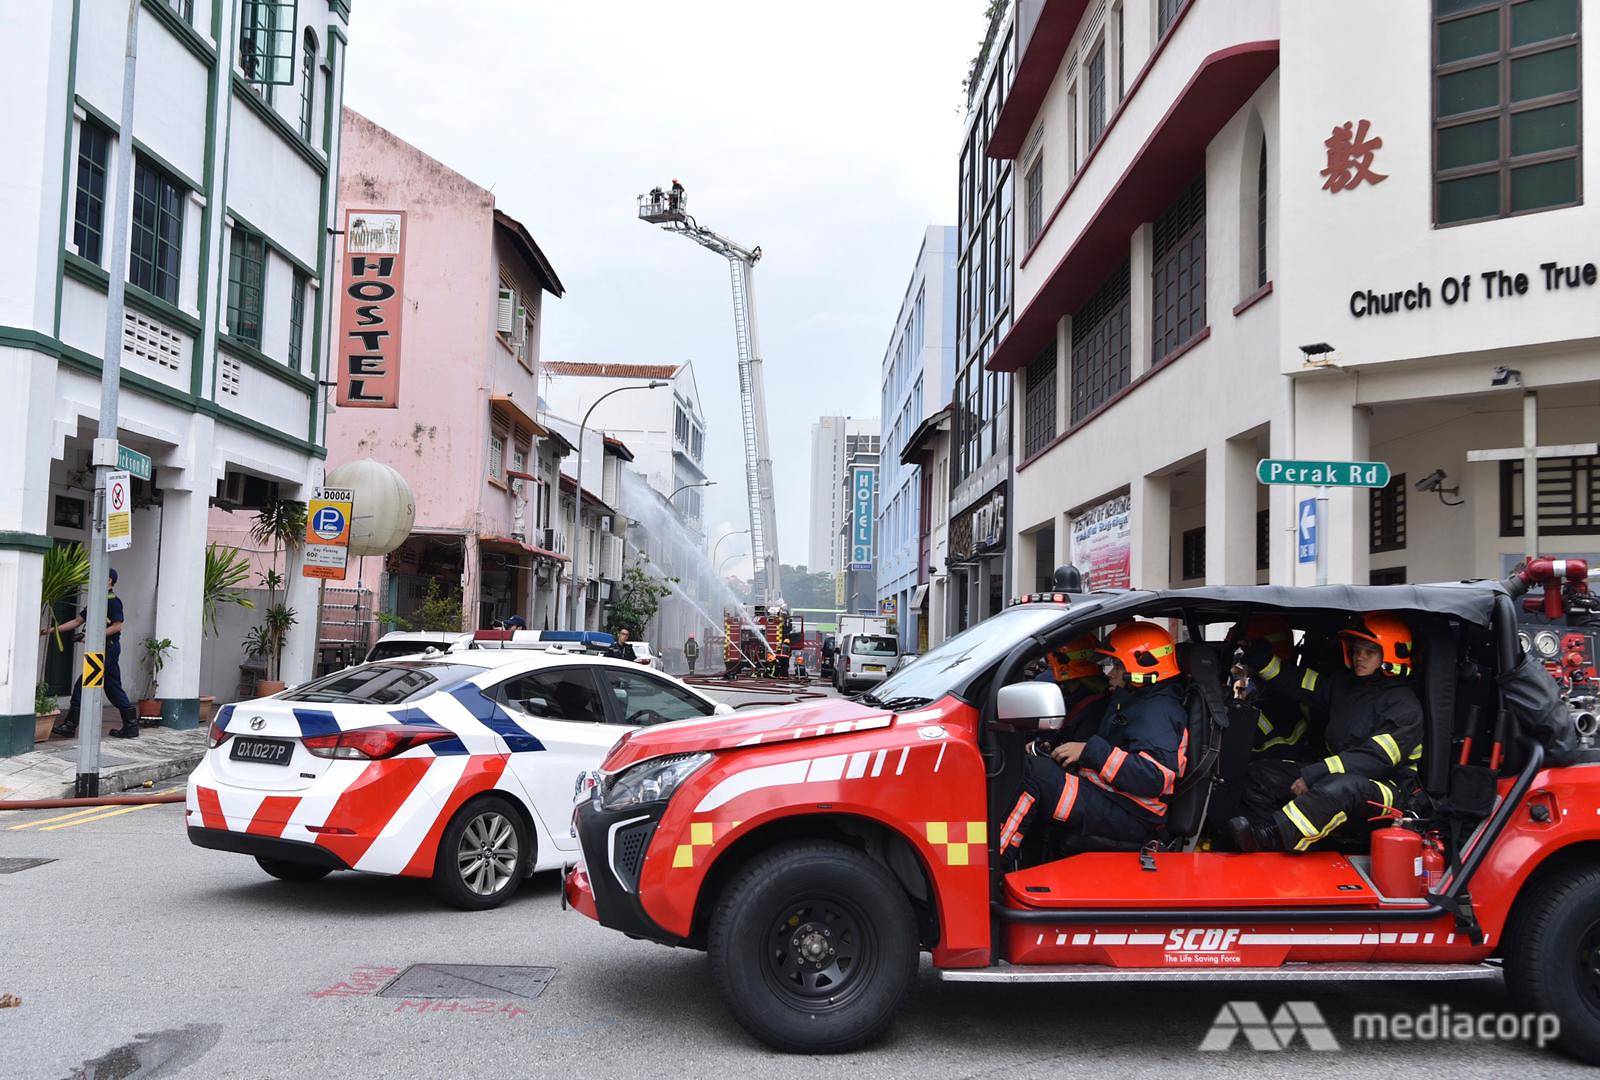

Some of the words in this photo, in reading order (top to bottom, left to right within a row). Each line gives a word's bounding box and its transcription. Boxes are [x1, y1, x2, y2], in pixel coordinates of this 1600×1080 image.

[1350, 282, 1431, 318] Church
[1441, 274, 1471, 305] Of
[1481, 270, 1529, 299] The
[1540, 261, 1598, 292] True
[346, 256, 396, 401] HOSTEL
[118, 449, 141, 473] ickson
[141, 457, 149, 477] Rd
[1271, 463, 1338, 482] Perak
[1349, 465, 1377, 484] Rd
[324, 491, 351, 501] D0004
[857, 474, 870, 541] HOTEL
[854, 546, 871, 562] 81
[237, 742, 286, 759] QX1027P
[1164, 928, 1240, 951] SCDF
[1164, 954, 1178, 963] The
[1180, 954, 1192, 963] Life
[1194, 954, 1219, 965] Saving
[1220, 954, 1241, 963] Force
